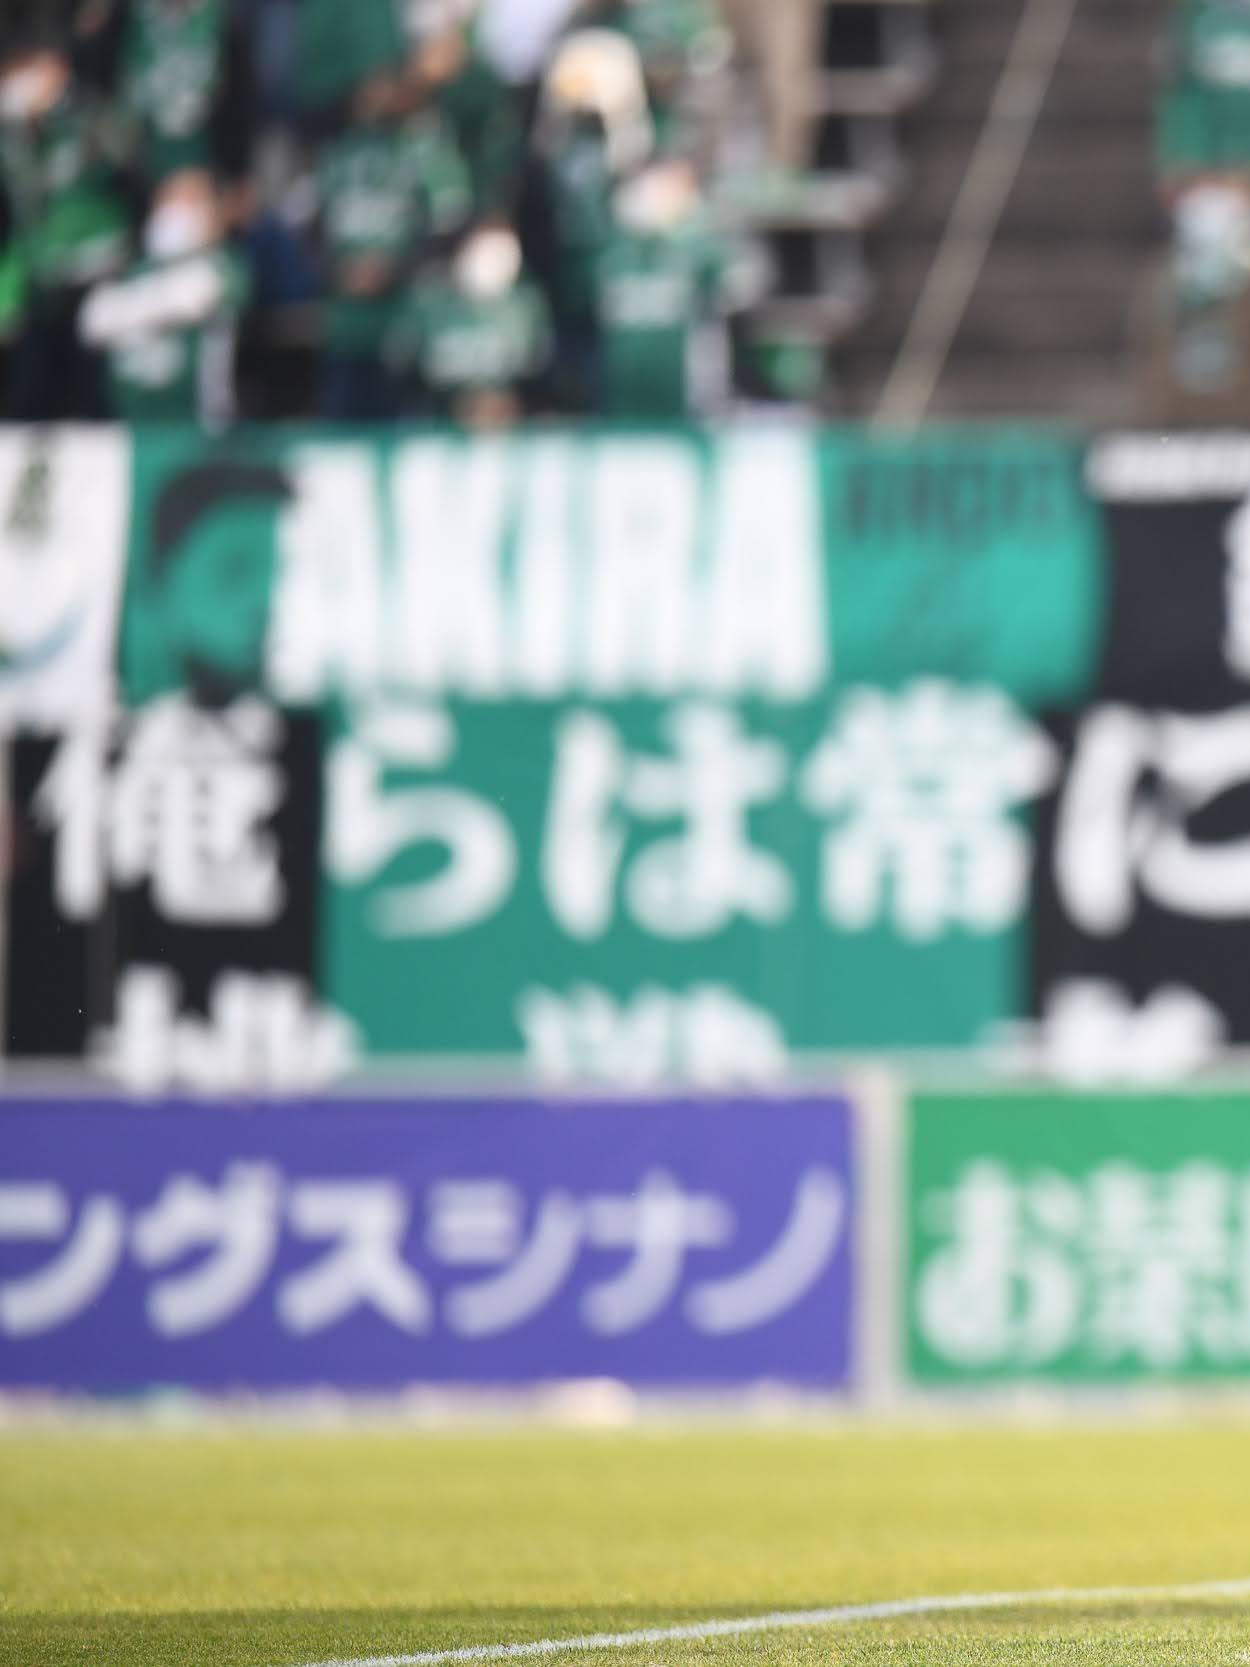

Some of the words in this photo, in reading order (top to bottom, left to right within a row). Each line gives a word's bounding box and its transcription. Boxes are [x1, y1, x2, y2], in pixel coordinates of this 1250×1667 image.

[266, 430, 830, 702] AKIRA
[0, 1158, 845, 1338] ングスシナノ
